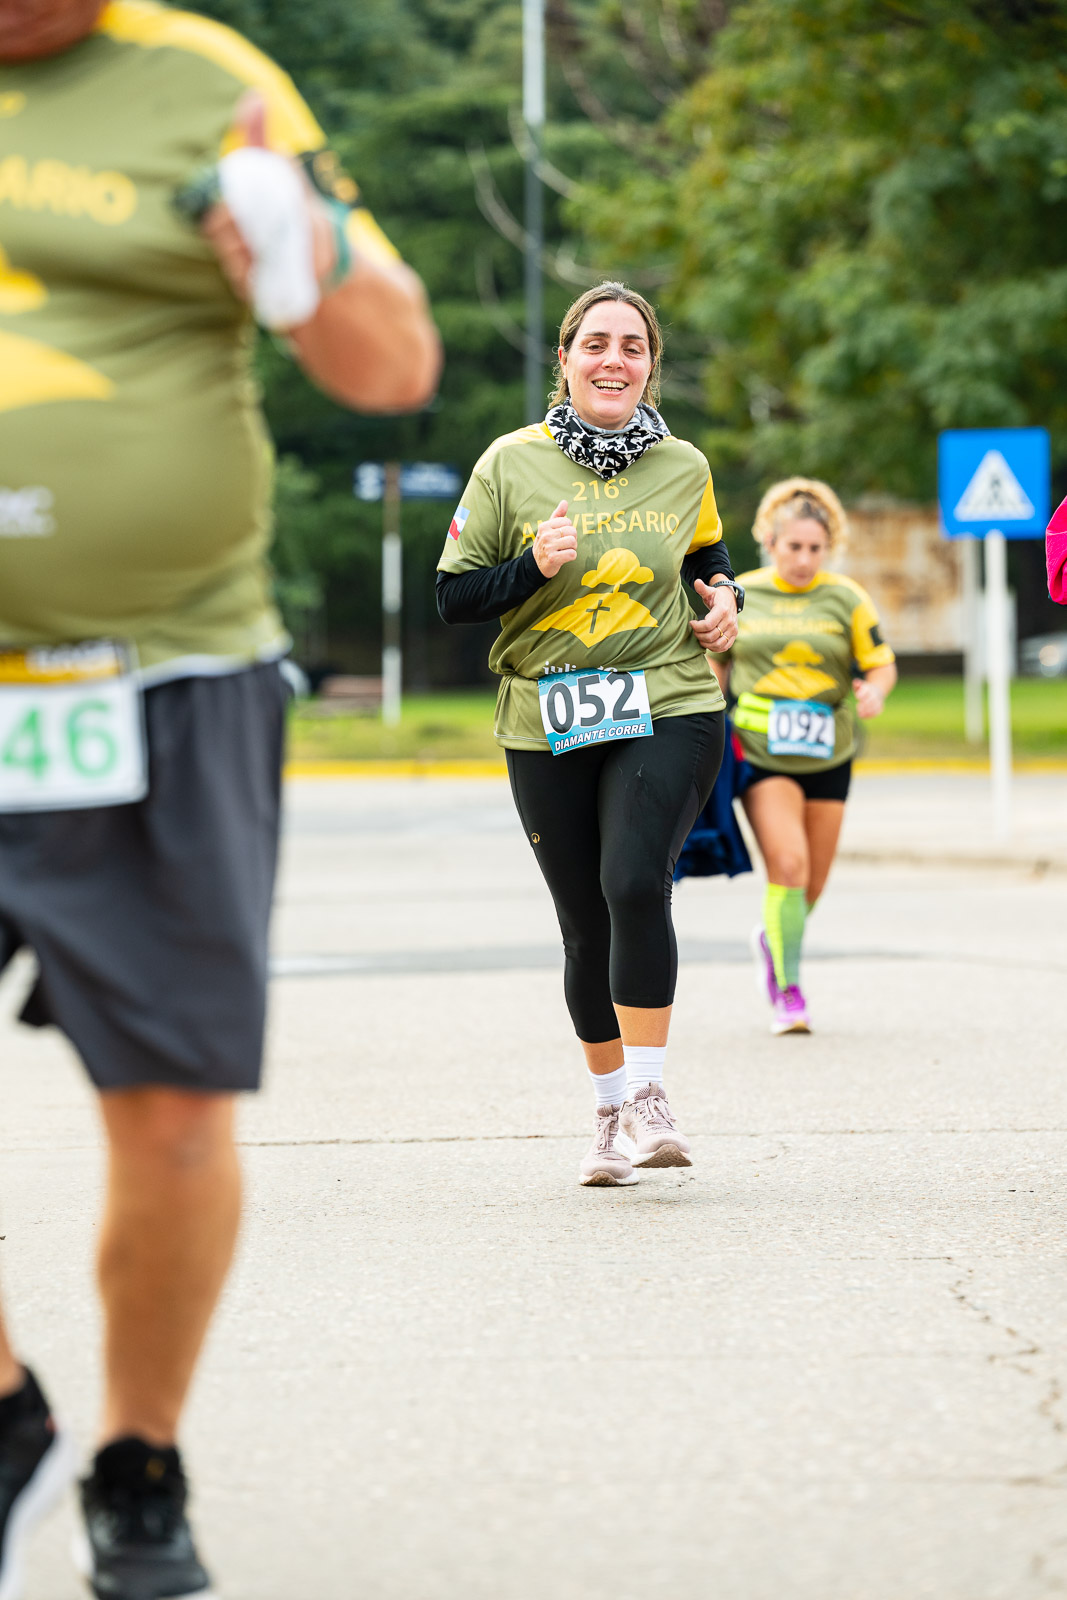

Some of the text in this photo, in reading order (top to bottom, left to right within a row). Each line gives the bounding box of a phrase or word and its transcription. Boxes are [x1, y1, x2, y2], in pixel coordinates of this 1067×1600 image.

[572, 478, 629, 502] 216°
[522, 510, 680, 545] AERSARIO
[546, 671, 641, 735] 052
[554, 723, 647, 752] DIAMANTE CORRE
[776, 709, 829, 745] 092
